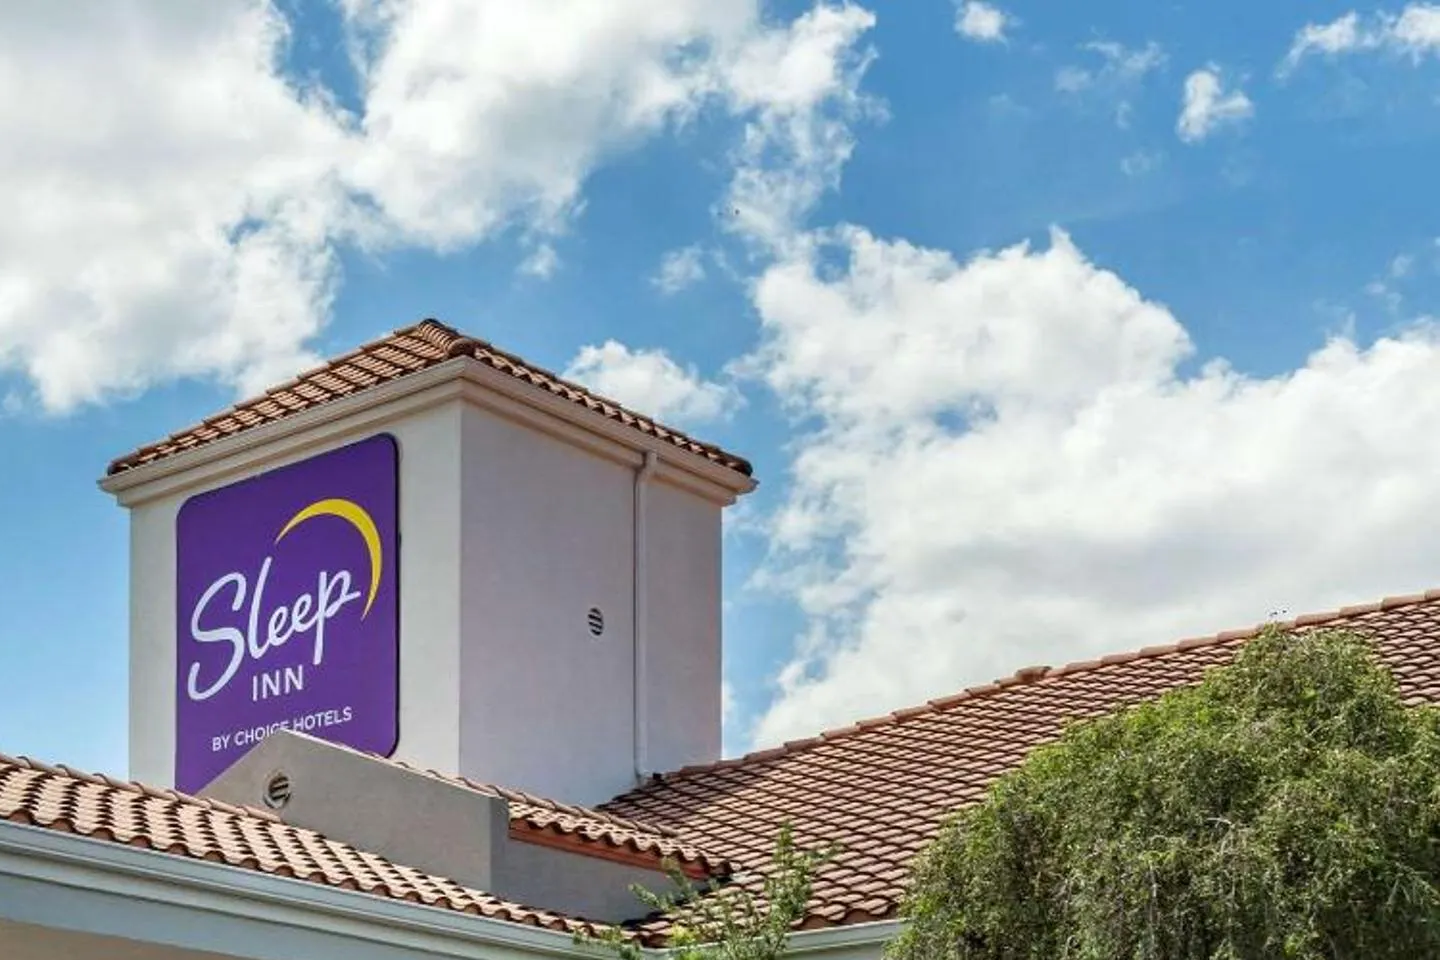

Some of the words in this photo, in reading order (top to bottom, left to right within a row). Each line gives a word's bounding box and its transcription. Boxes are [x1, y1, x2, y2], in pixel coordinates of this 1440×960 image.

[187, 556, 361, 700] Sleep
[252, 665, 303, 701] INN
[212, 734, 231, 752] BY
[293, 706, 352, 732] HOTELS
